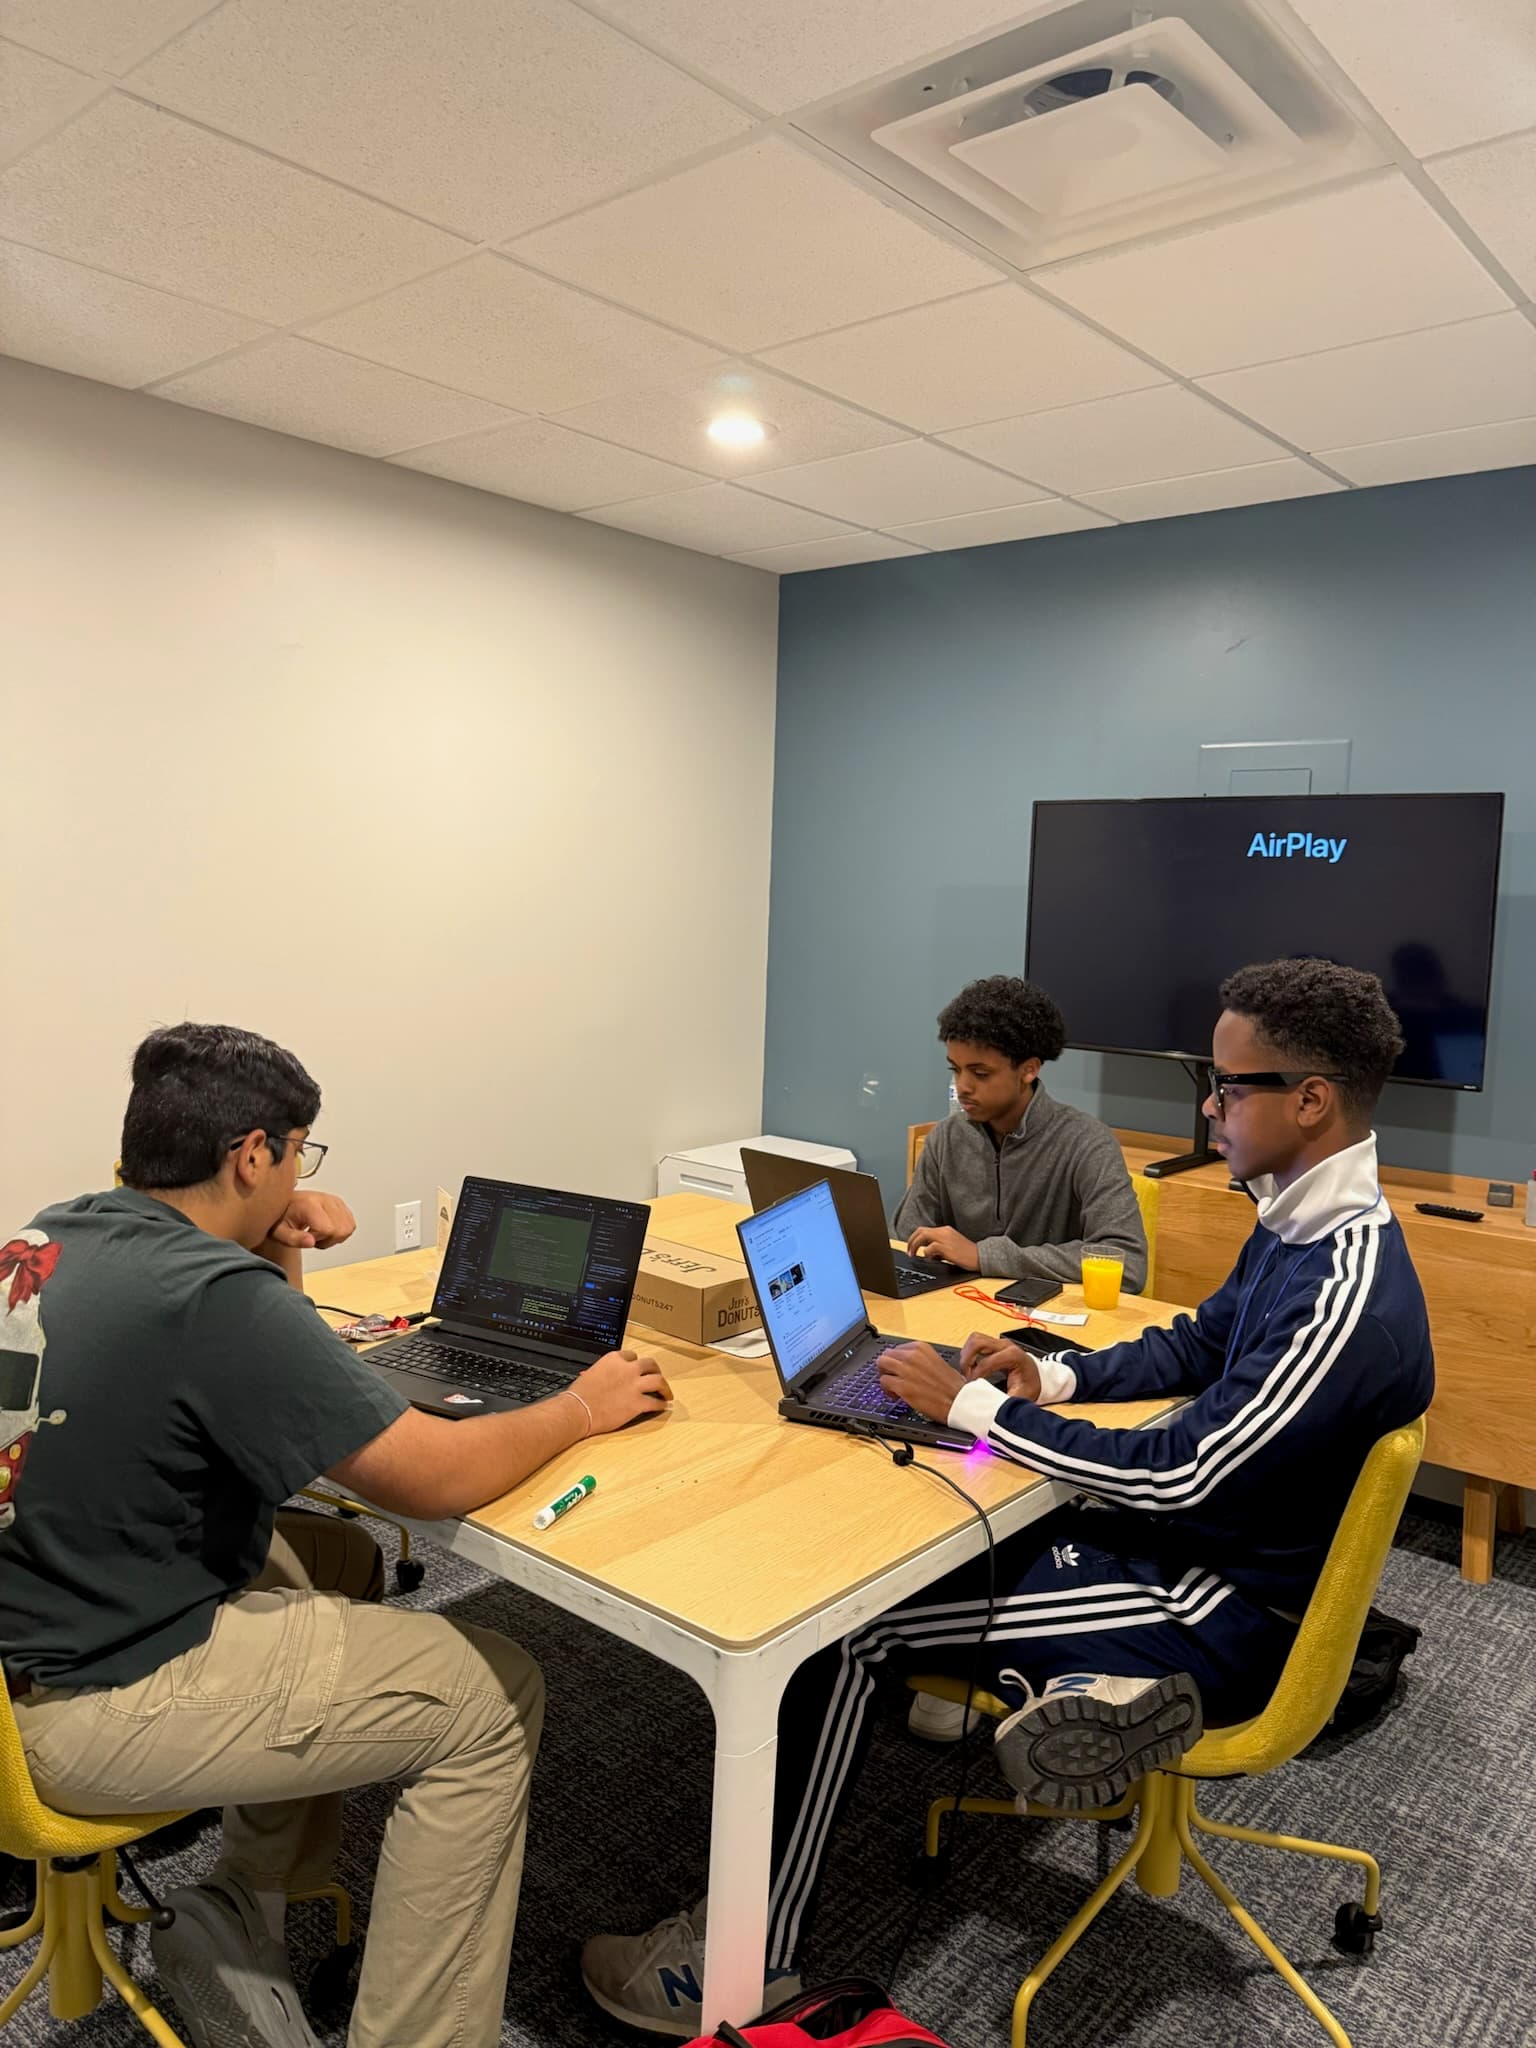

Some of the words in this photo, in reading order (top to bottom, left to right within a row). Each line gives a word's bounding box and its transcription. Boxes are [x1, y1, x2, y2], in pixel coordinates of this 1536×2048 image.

[1247, 832, 1347, 863] AirPlay
[718, 1304, 761, 1328] DONUTS
[1051, 1546, 1063, 1569] adidas
[656, 1963, 703, 2009] N
